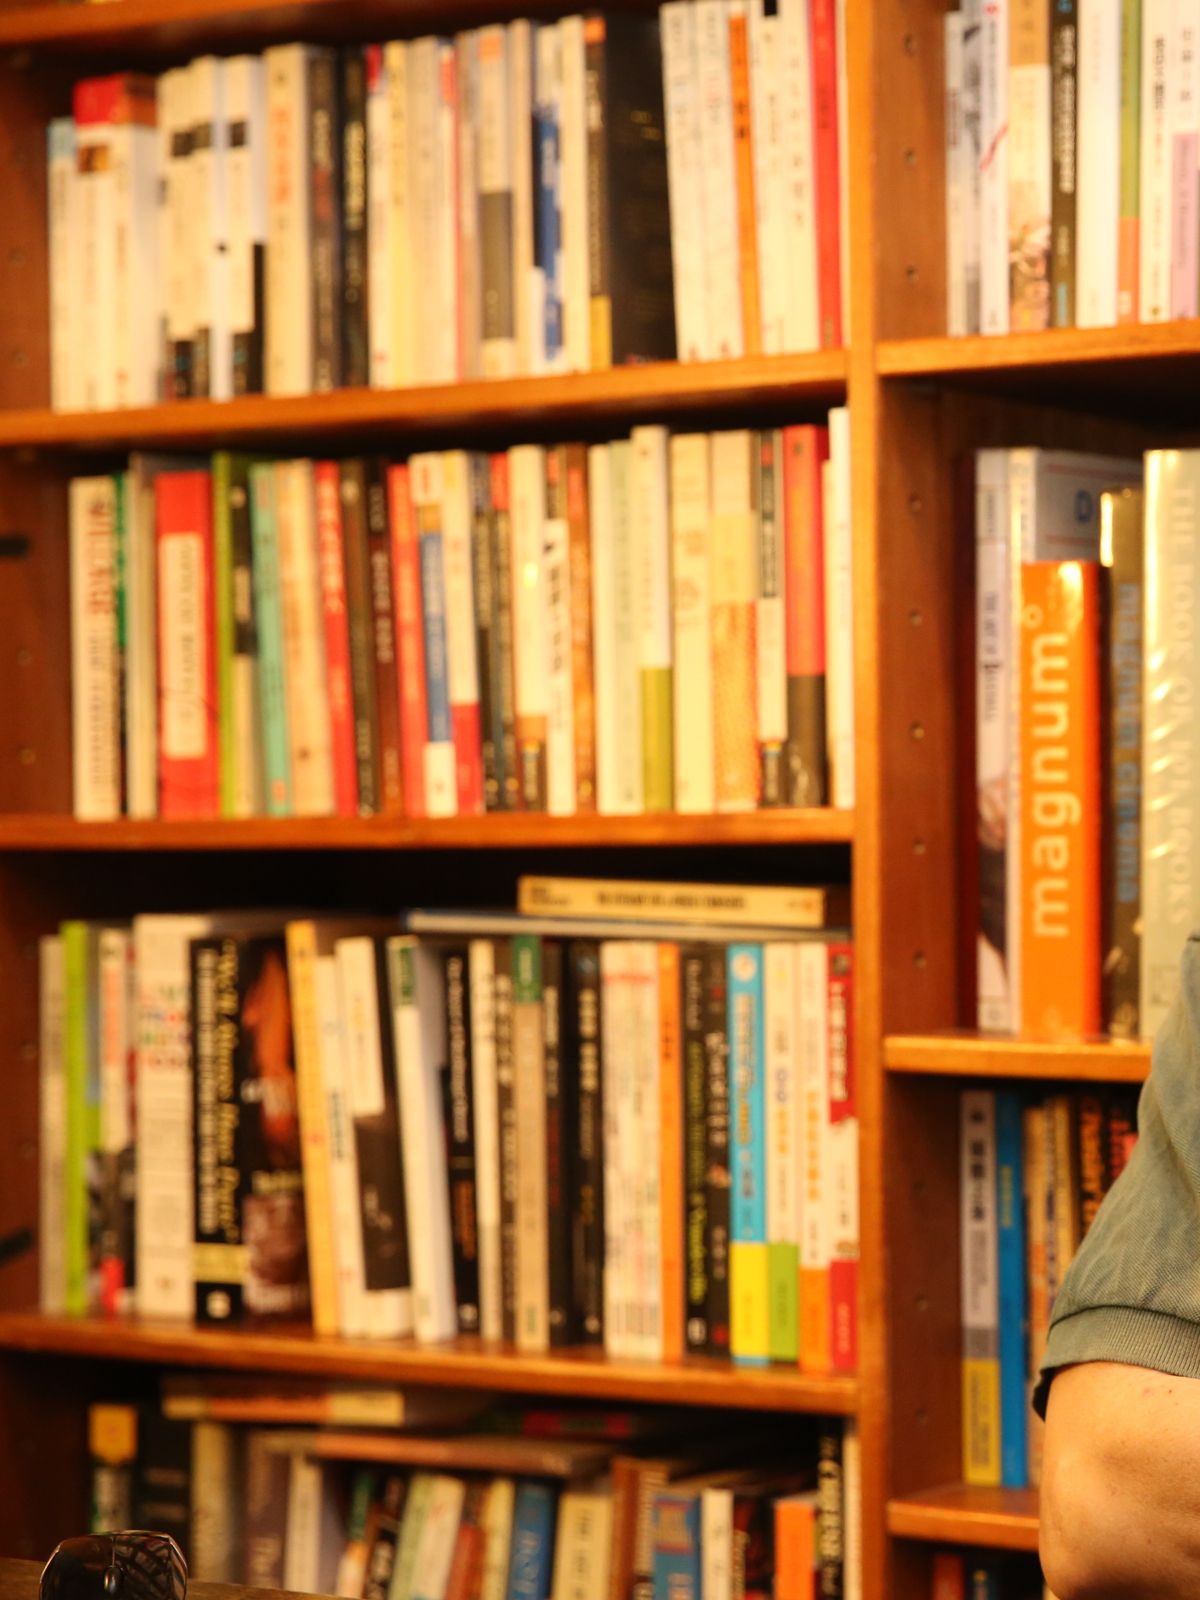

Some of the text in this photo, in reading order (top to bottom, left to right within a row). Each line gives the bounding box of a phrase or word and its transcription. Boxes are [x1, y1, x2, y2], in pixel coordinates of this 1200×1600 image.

[1171, 563, 1195, 662] BOOK
[1031, 633, 1082, 938] magnum
[1167, 805, 1192, 925] BOOKS
